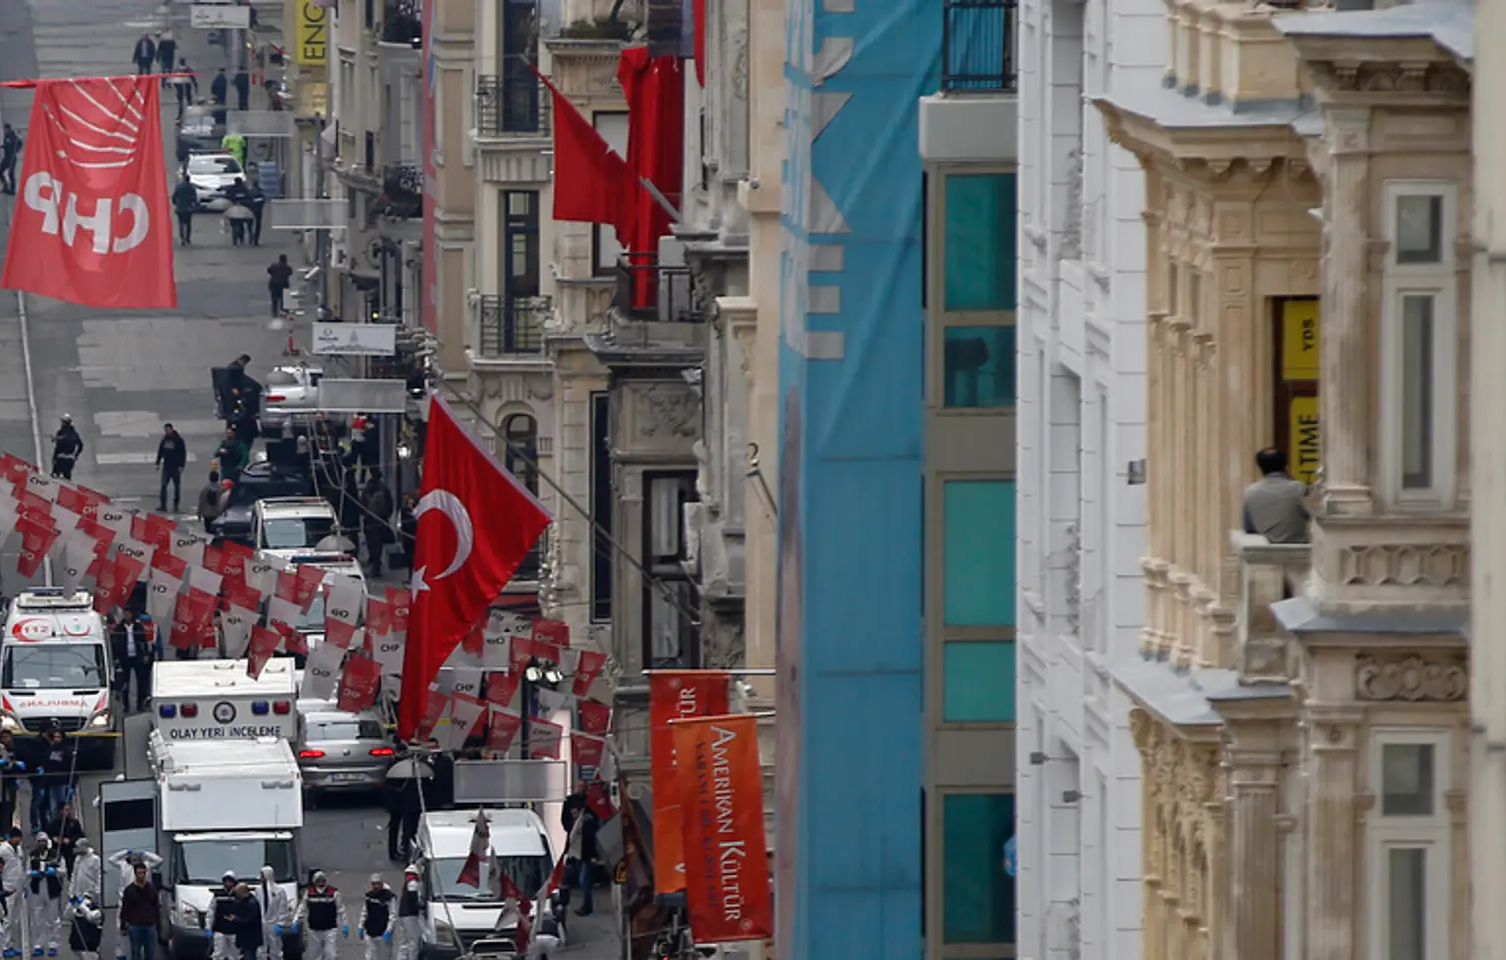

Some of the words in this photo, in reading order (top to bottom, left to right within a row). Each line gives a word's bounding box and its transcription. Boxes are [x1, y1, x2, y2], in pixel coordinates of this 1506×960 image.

[380, 643, 401, 653] CHP
[169, 728, 199, 739] OLAY
[200, 726, 226, 737] YERİ
[717, 840, 747, 922] KÜLTÜR
